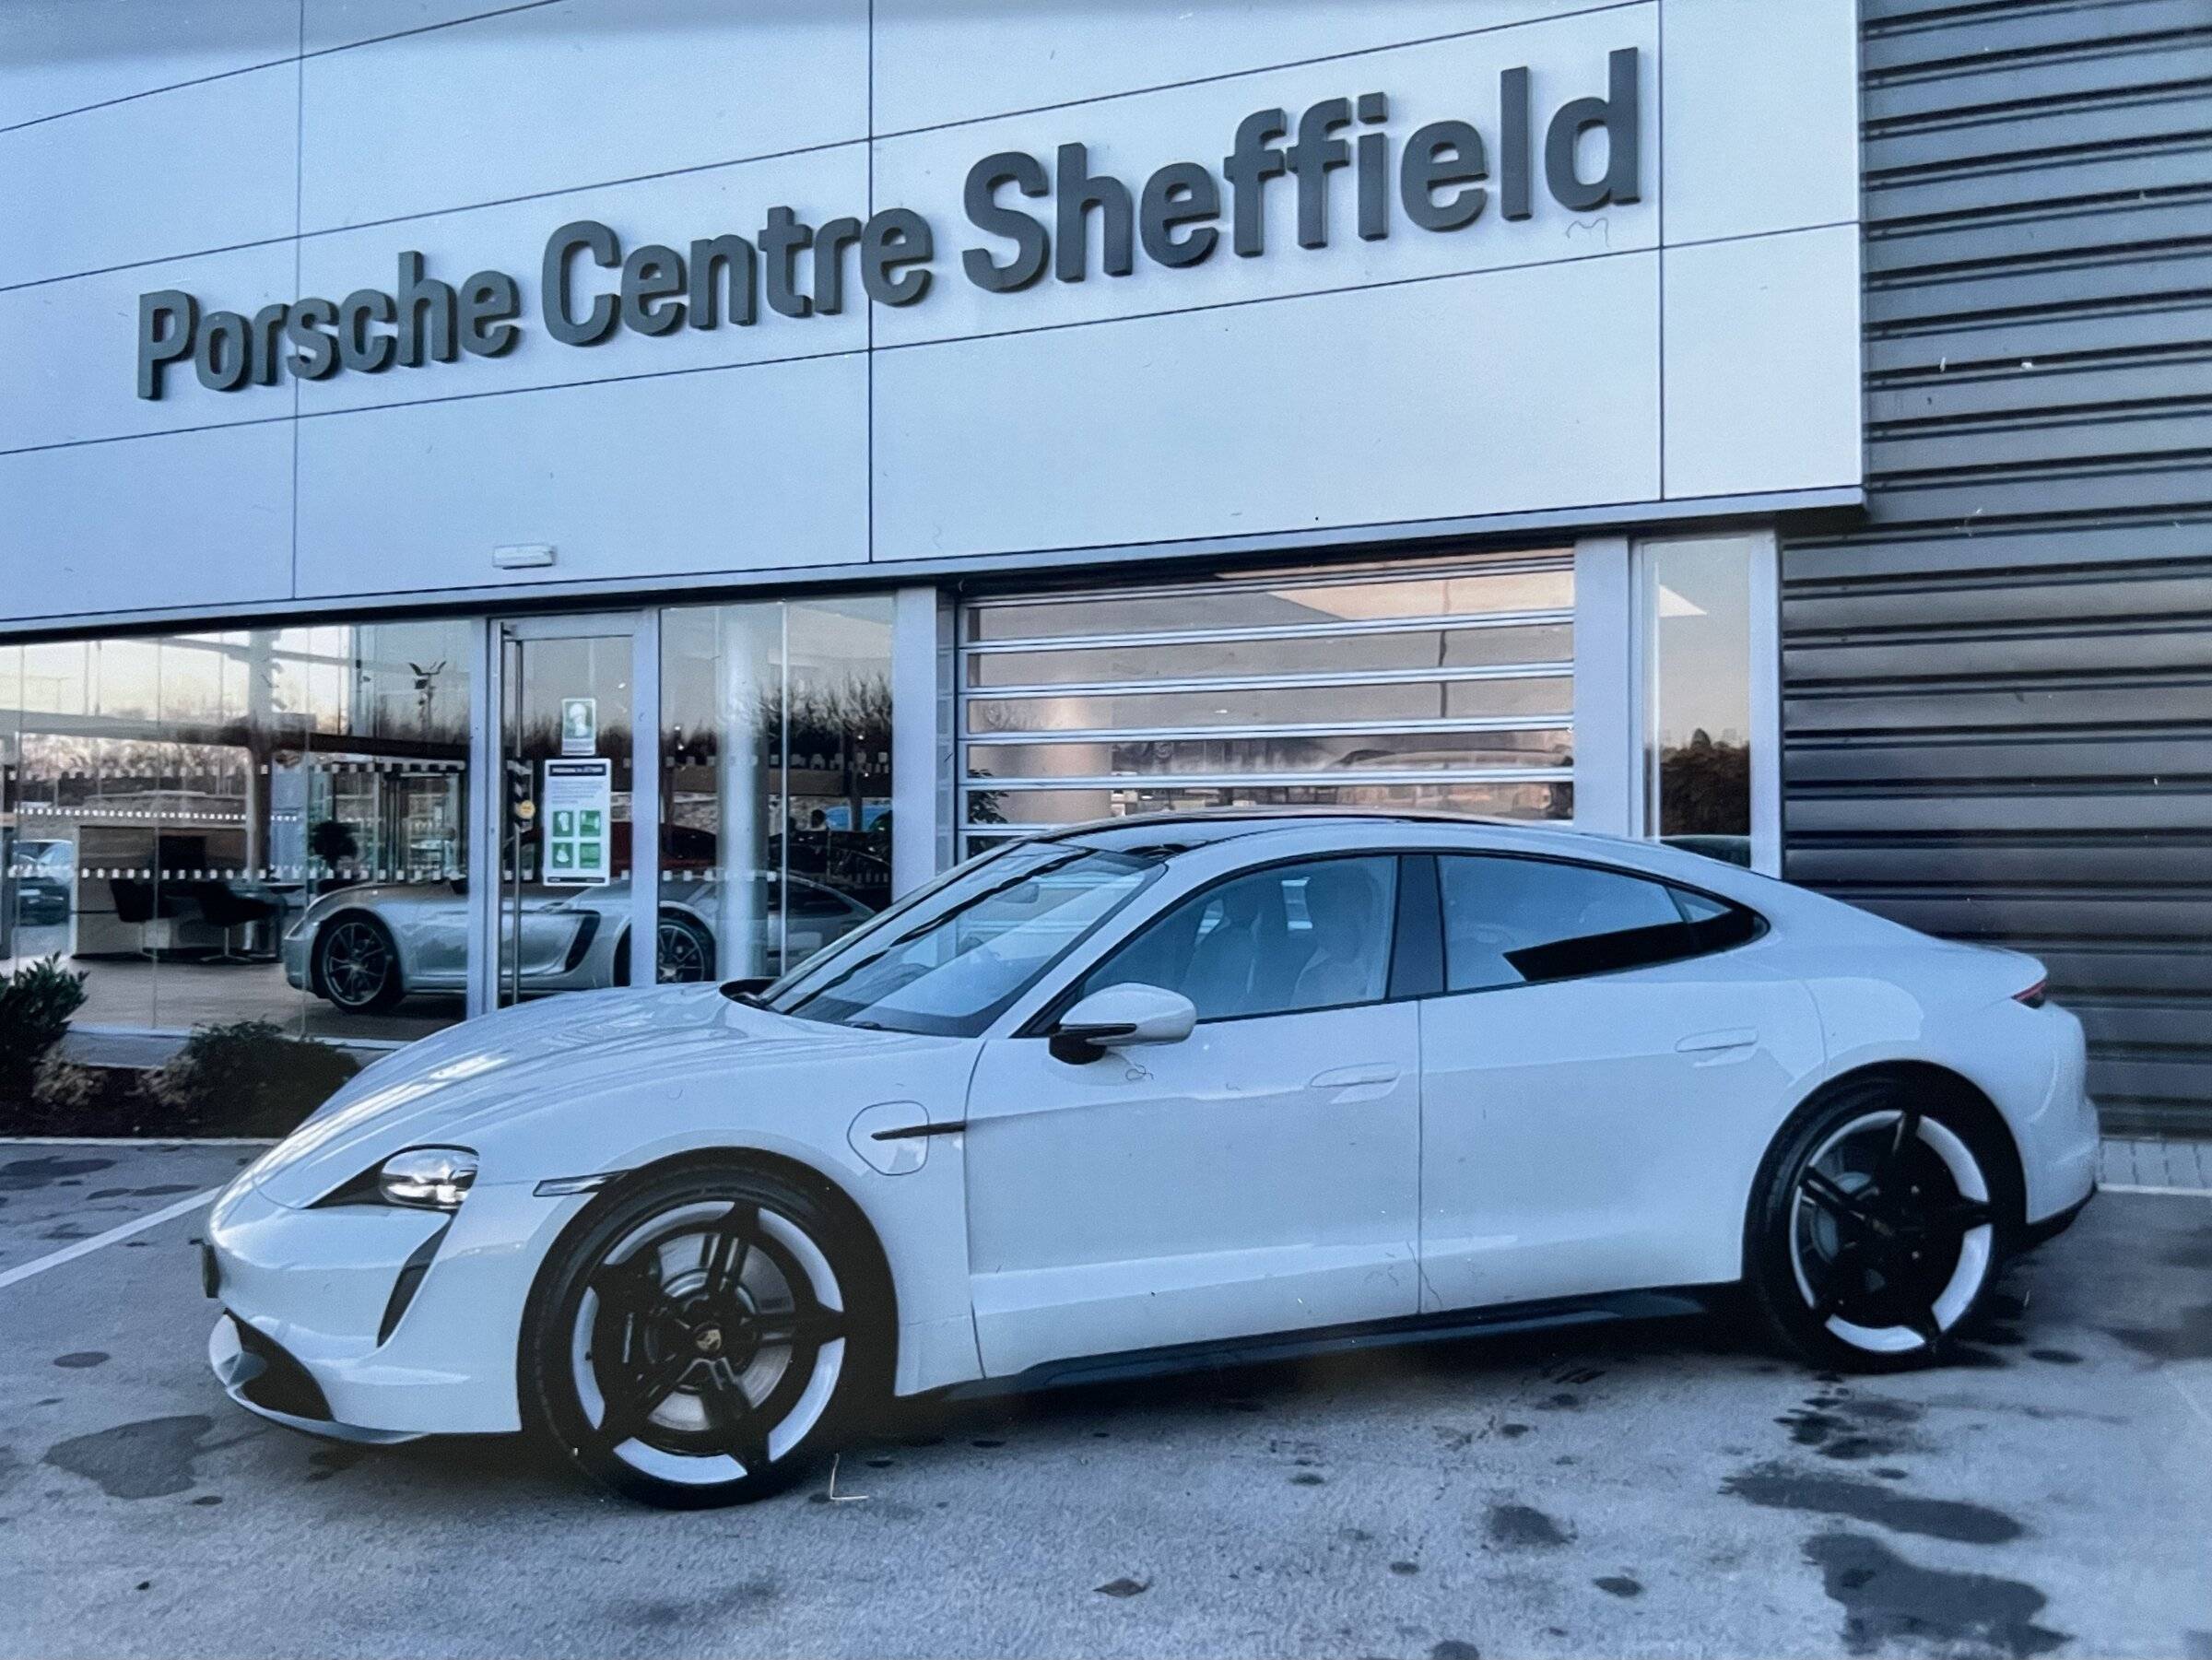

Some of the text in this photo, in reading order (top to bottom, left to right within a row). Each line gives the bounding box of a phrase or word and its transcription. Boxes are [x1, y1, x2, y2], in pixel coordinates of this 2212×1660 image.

[137, 46, 1643, 402] Porsche Centre Sheffield
